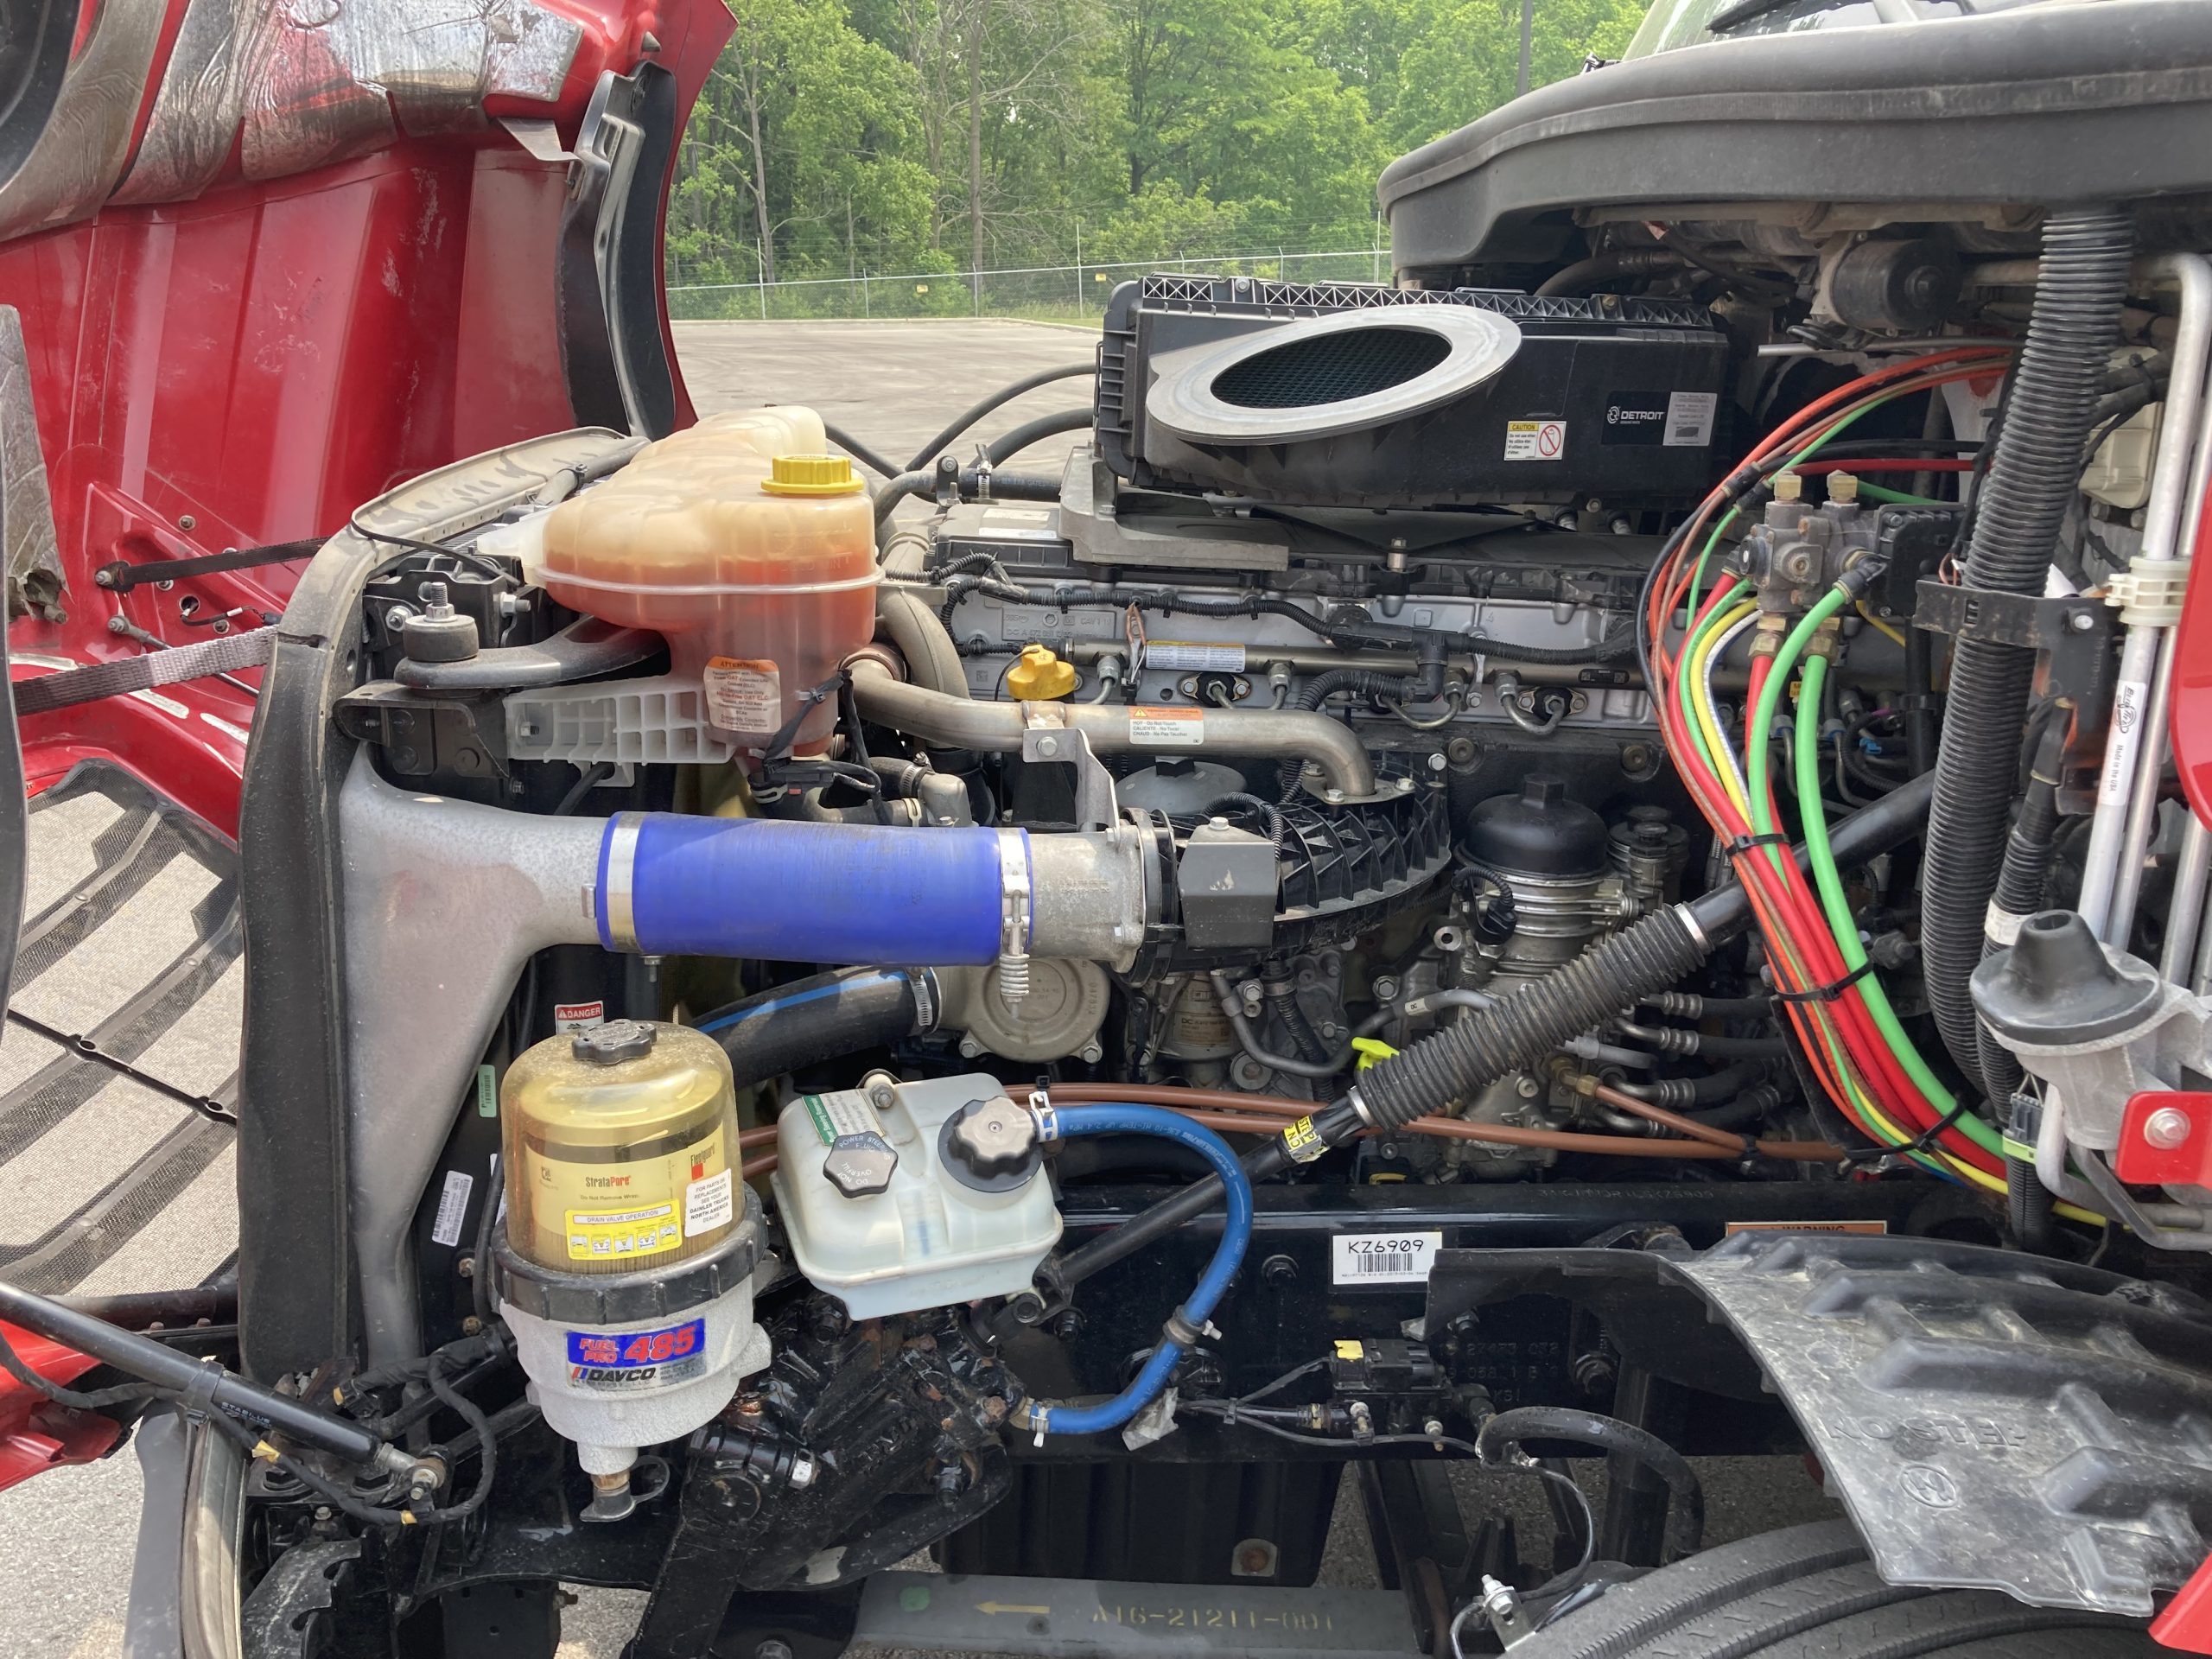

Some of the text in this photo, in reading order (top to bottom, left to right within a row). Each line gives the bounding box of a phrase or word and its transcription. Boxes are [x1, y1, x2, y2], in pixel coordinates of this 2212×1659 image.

[1621, 410, 1664, 420] DETROIT
[567, 1007, 601, 1019] DANGER
[838, 1135, 865, 1148] POWER
[836, 1172, 852, 1183] NOT
[694, 1183, 727, 1199] REPLACEMENTS
[690, 1195, 730, 1214] DAIMLER TRUCKS
[690, 1202, 729, 1220] NORTH AMERICA
[625, 1210, 658, 1220] OPERATION
[702, 1212, 721, 1224] DEALER
[1348, 1239, 1424, 1254] KZ6909
[579, 1325, 697, 1363] FUEL 485
[583, 1350, 618, 1363] PRO
[587, 1367, 655, 1382] DAVCO
